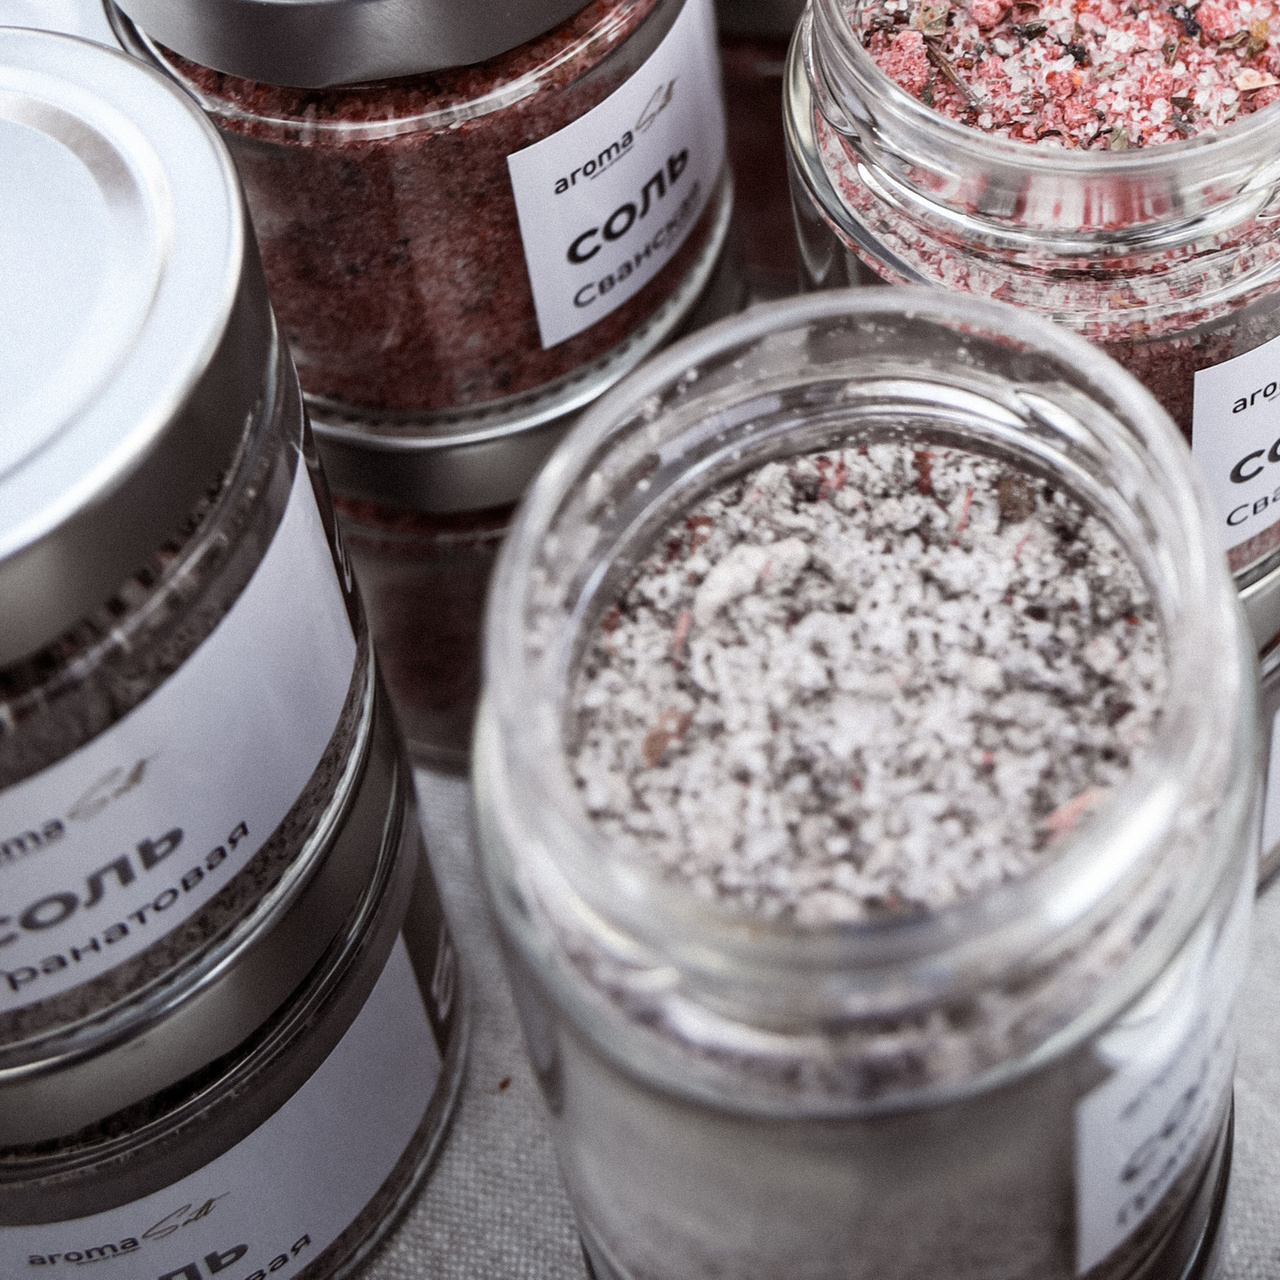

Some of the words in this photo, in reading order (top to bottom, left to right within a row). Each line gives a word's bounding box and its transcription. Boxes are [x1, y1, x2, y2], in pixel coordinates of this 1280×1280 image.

[554, 130, 635, 195] aroma
[0, 821, 249, 992] ранатовая
[28, 1237, 140, 1266] aroma
